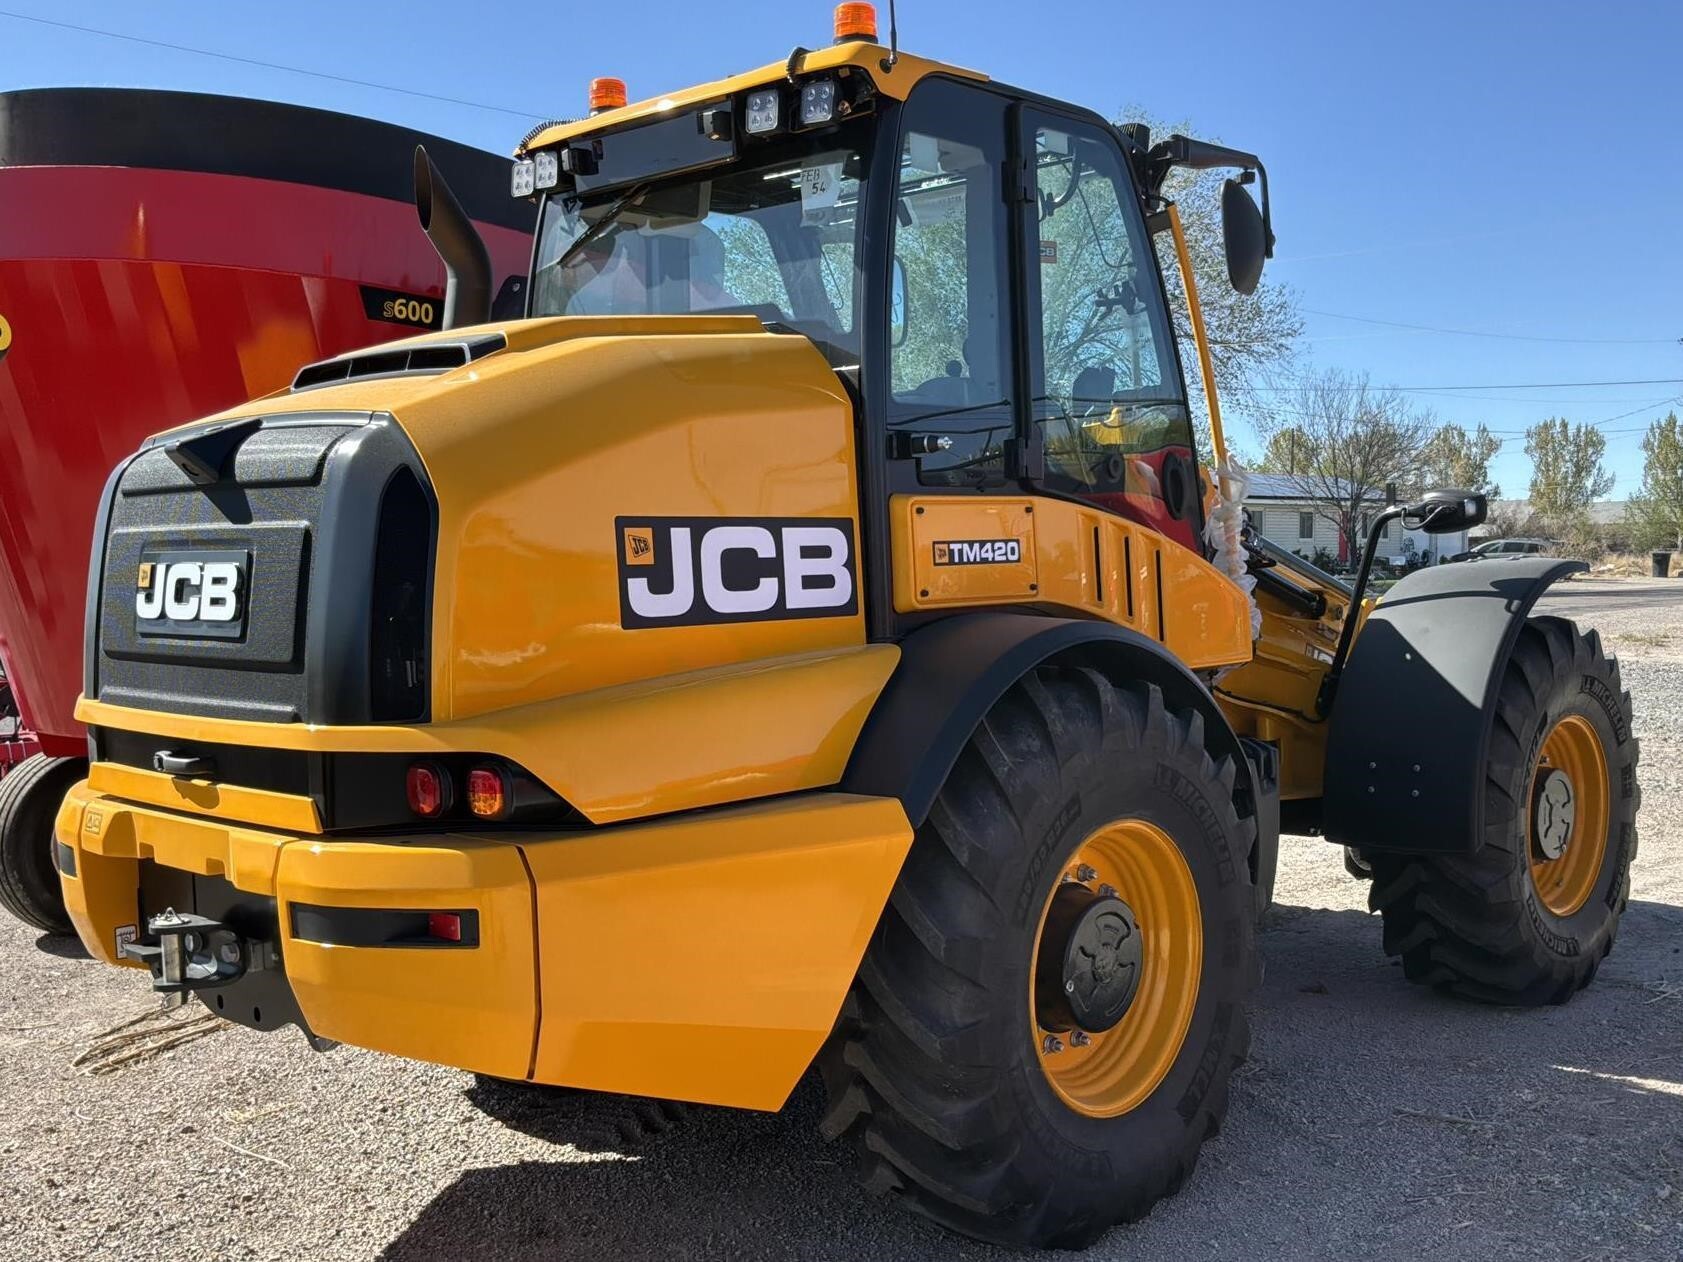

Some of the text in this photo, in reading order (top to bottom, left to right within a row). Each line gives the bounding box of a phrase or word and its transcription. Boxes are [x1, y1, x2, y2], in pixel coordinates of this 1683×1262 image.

[811, 181, 826, 194] 54
[949, 541, 1019, 562] TM420
[136, 562, 239, 620] JCB
[627, 526, 852, 618] JCB
